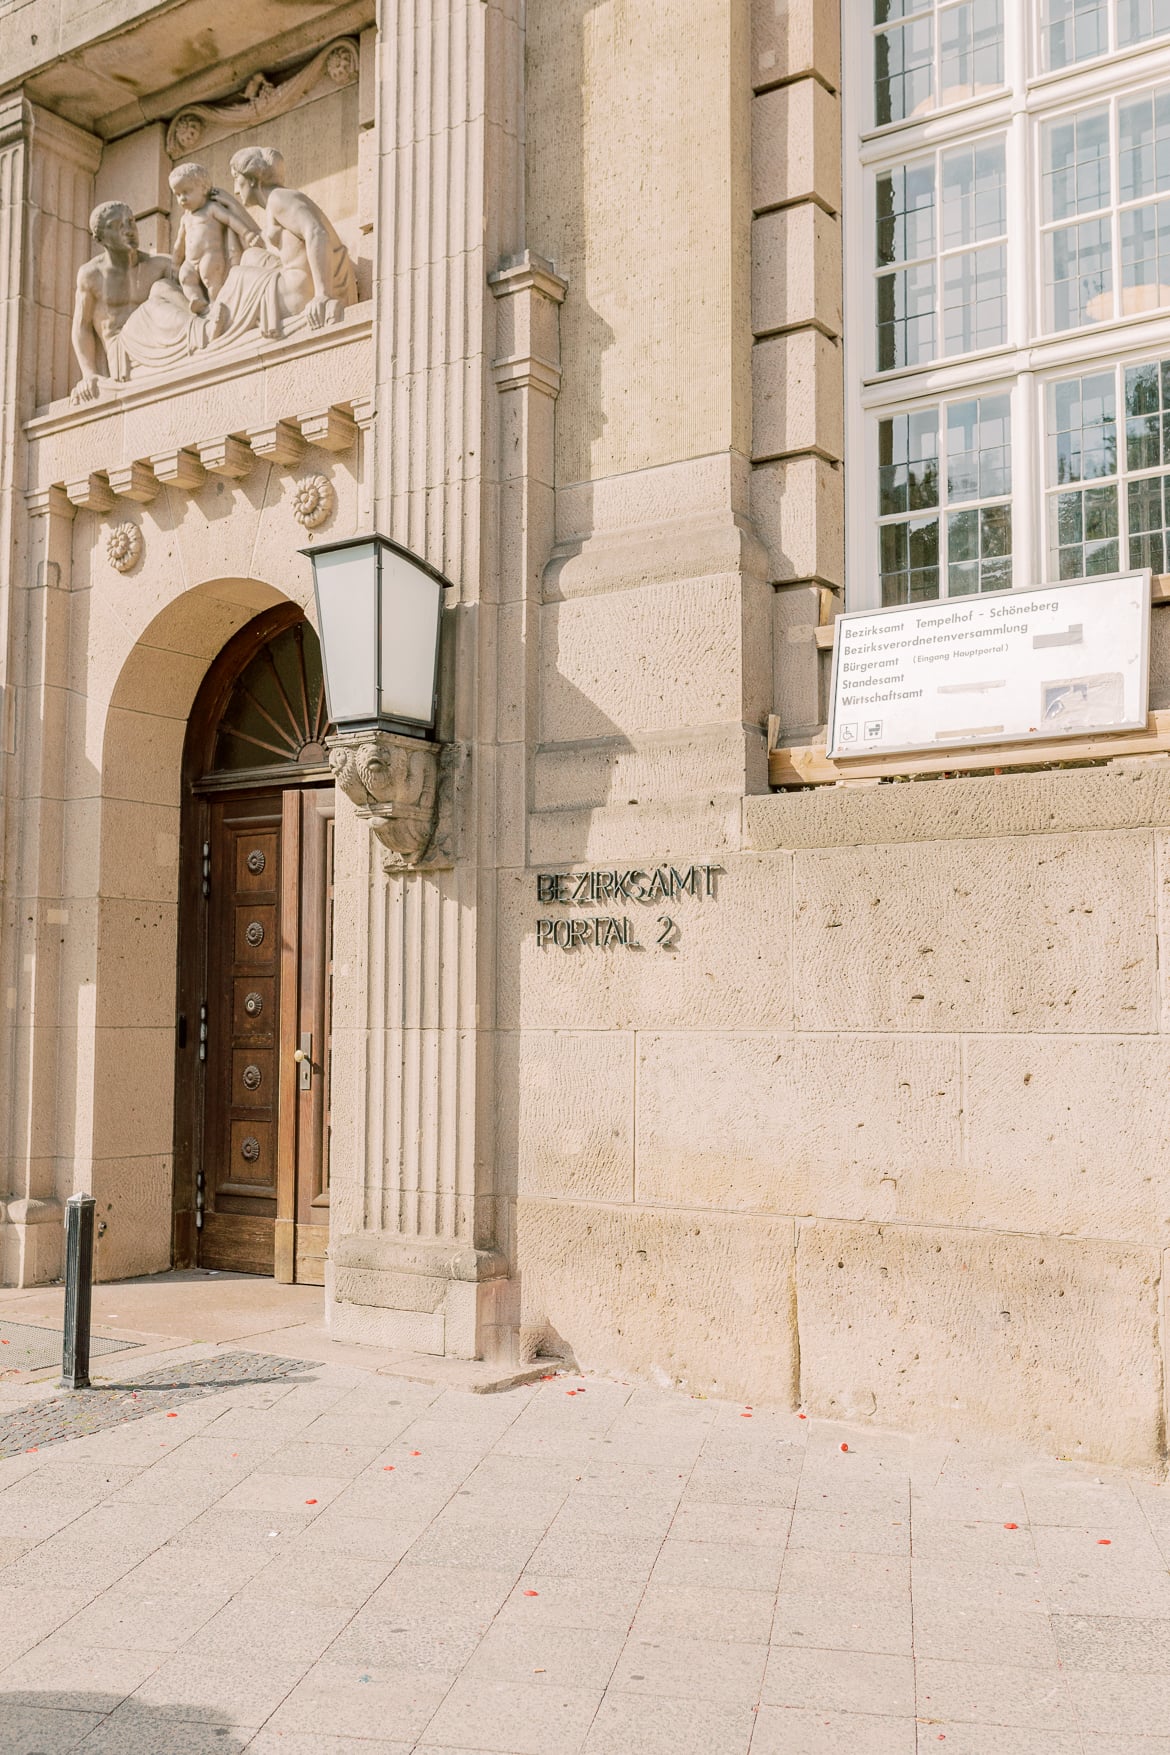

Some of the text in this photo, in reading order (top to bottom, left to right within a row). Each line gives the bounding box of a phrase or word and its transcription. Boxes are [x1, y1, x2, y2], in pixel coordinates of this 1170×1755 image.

[845, 622, 905, 639] Bezirksamt
[915, 610, 973, 629] Tempelhof
[989, 600, 1059, 619] Schöneberg
[844, 622, 1029, 655] Bezirksverordnetenversammlung
[843, 643, 1009, 673] Bürgeramt (Eingang Hauptportal)
[842, 674, 905, 690] Standesamt
[842, 688, 923, 706] Wirtschaftsamt
[537, 864, 721, 902] BEZIRKSAMT
[536, 916, 673, 948] PORTAL 2
